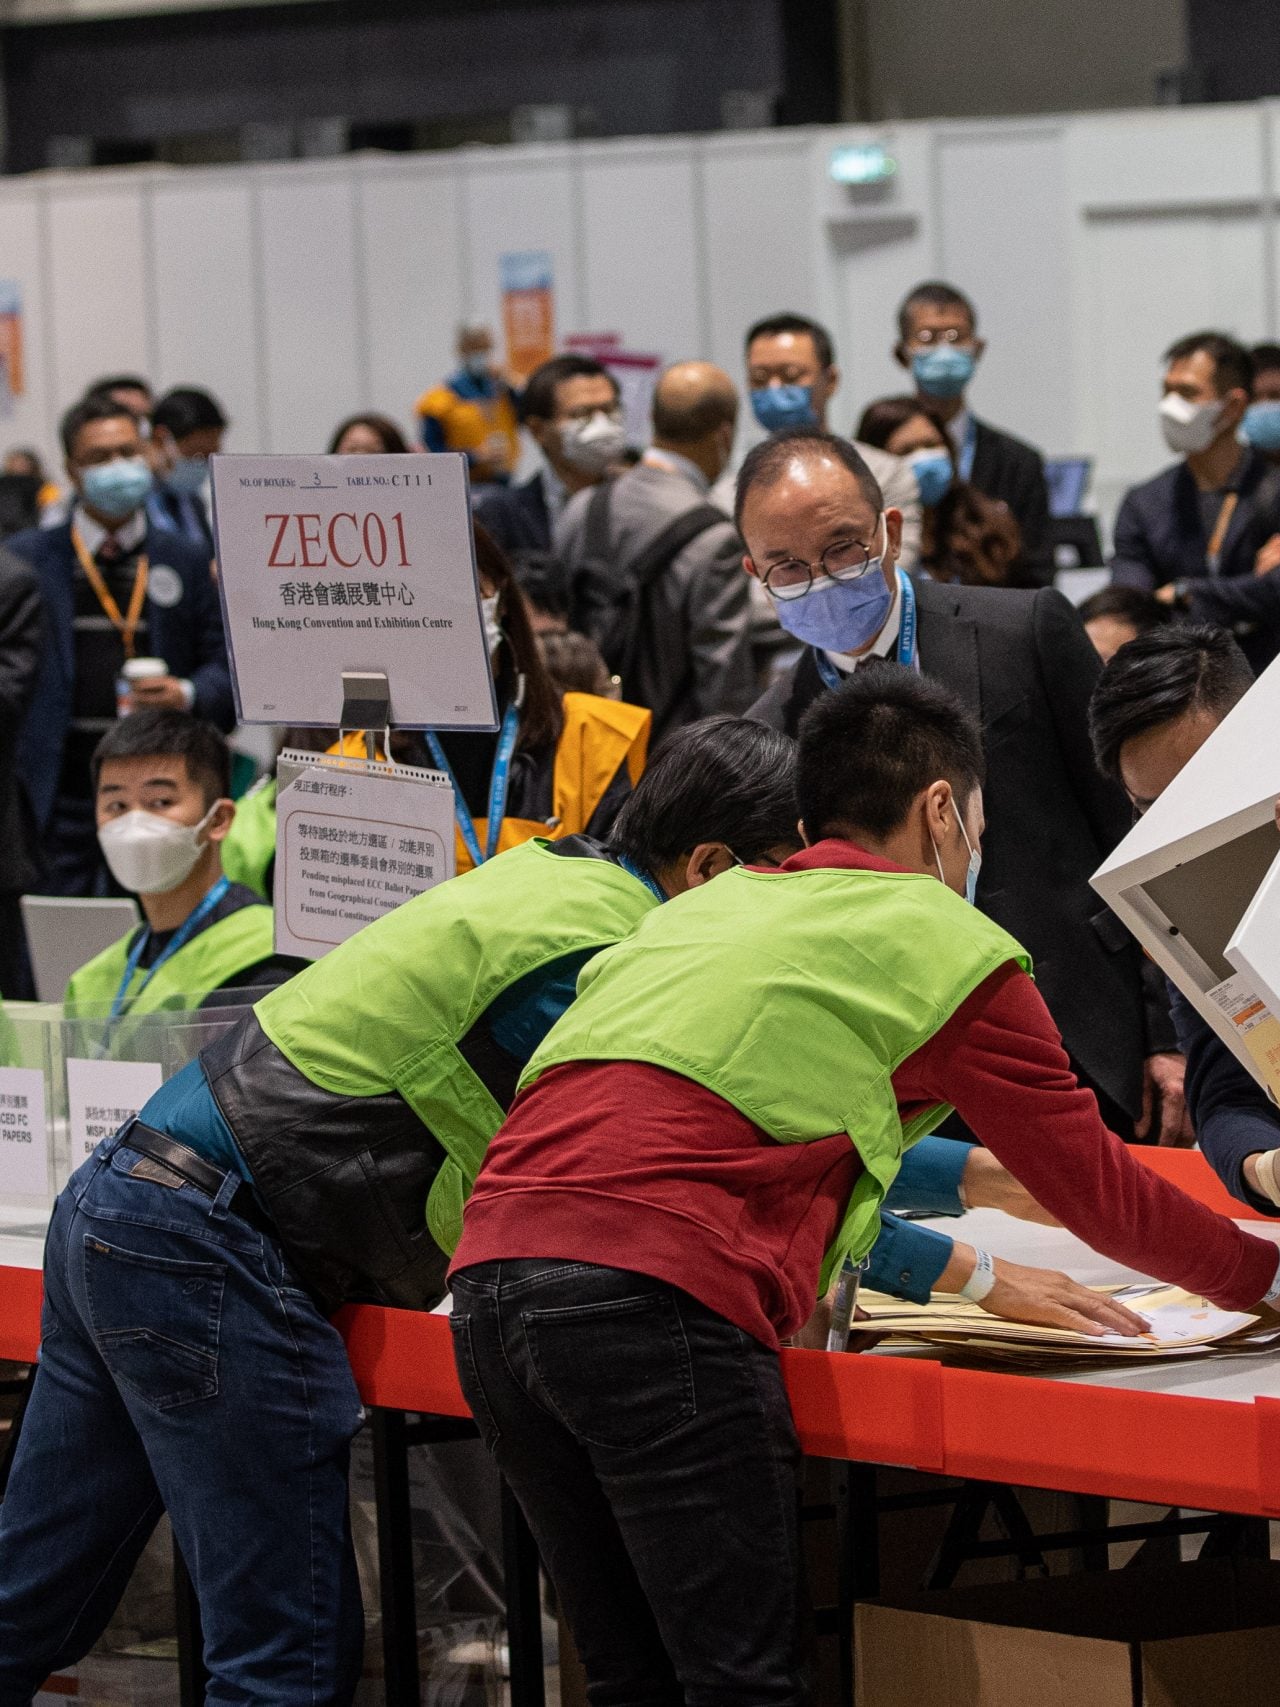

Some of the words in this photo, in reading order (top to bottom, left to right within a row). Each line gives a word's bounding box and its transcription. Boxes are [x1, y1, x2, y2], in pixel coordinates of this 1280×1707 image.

[252, 478, 262, 488] OF
[313, 472, 322, 486] 3
[346, 476, 373, 487] TABLE
[264, 511, 413, 568] ZEC01
[279, 581, 415, 607] 香港會議展覽中心
[252, 616, 276, 632] Hong
[277, 617, 302, 632] Kong
[303, 616, 354, 629] Convention
[356, 616, 372, 628] and
[374, 616, 421, 628] Exhibition
[422, 616, 453, 629] Centre
[301, 869, 330, 883] Pending
[331, 875, 365, 888] misplaced
[366, 878, 383, 890] ECC
[384, 881, 404, 893] Ballot
[309, 887, 326, 898] from
[327, 890, 373, 905] Geographical
[300, 903, 337, 917] Functional
[17, 1114, 28, 1126] FC
[2, 1129, 32, 1143] PAPERS
